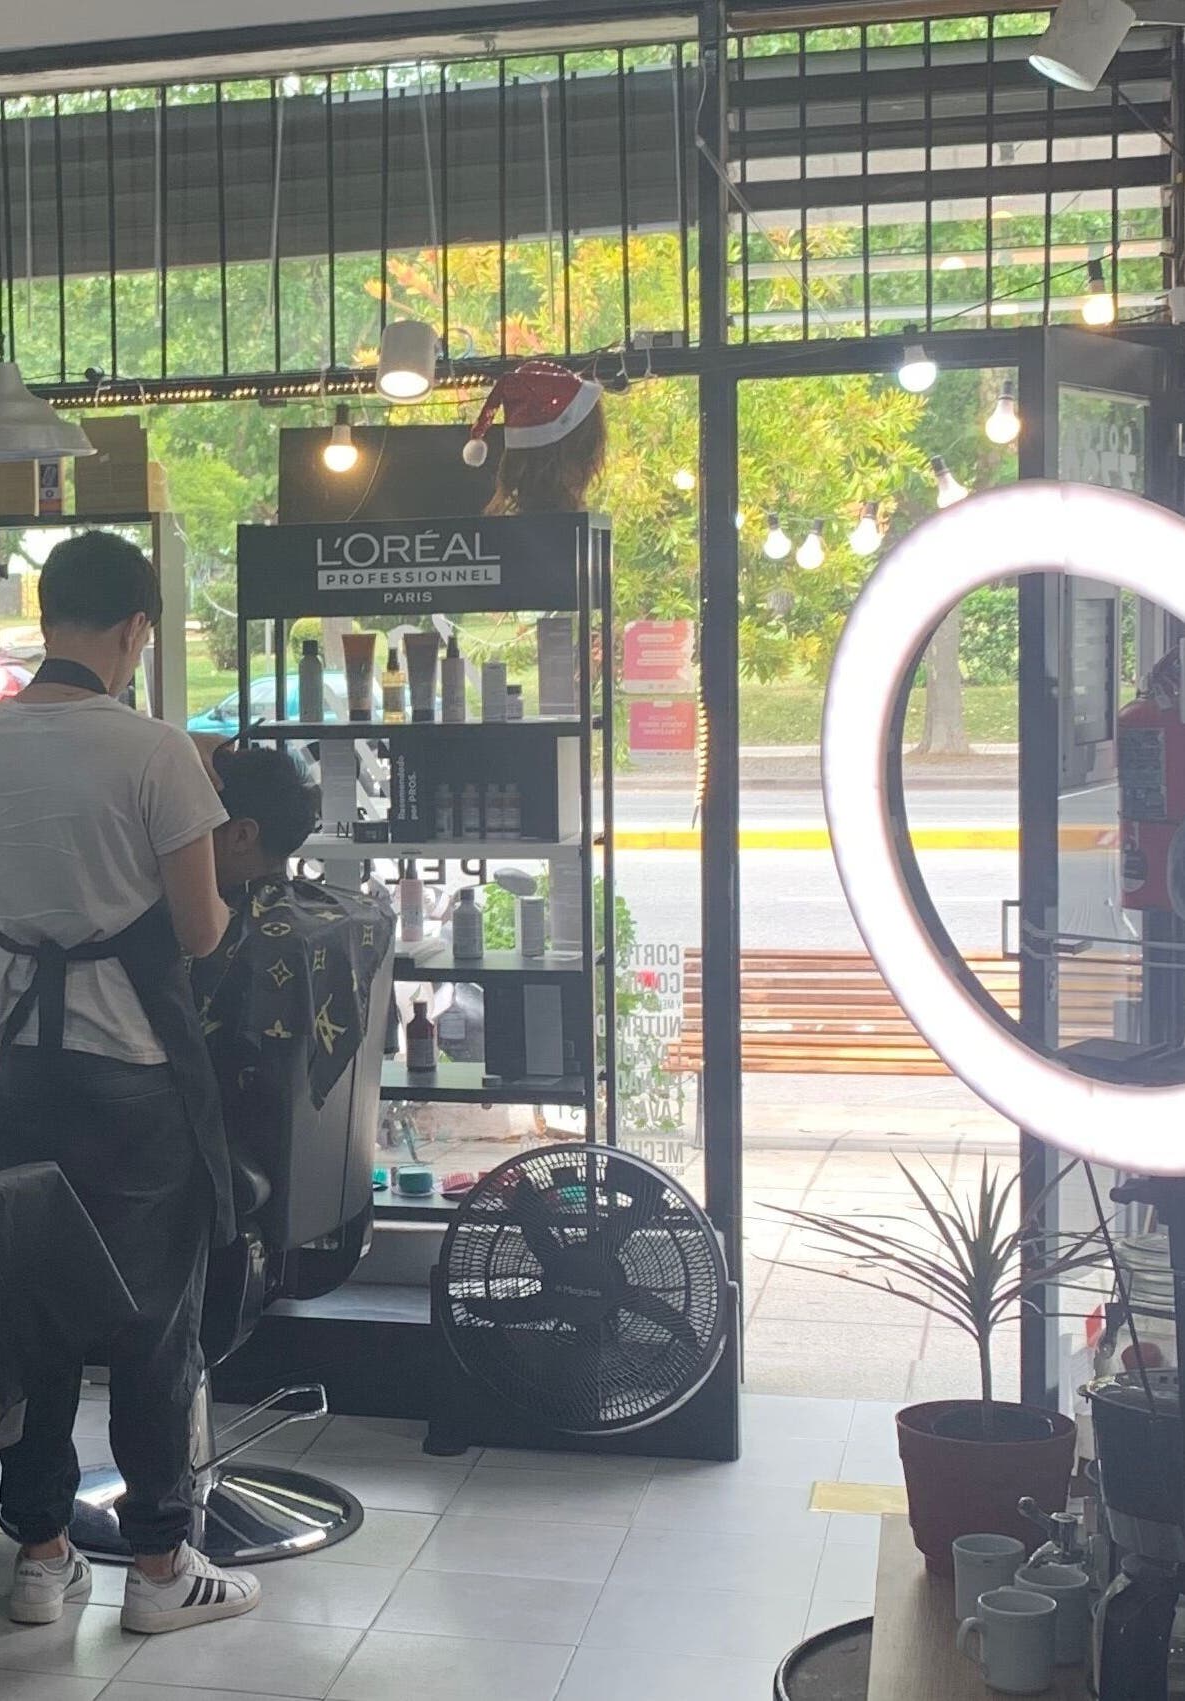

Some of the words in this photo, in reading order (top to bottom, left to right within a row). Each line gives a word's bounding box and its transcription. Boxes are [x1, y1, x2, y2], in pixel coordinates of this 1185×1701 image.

[316, 529, 501, 568] L'ORÉAL
[326, 568, 494, 586] PROFESSIONNEL
[383, 590, 433, 604] PARIS
